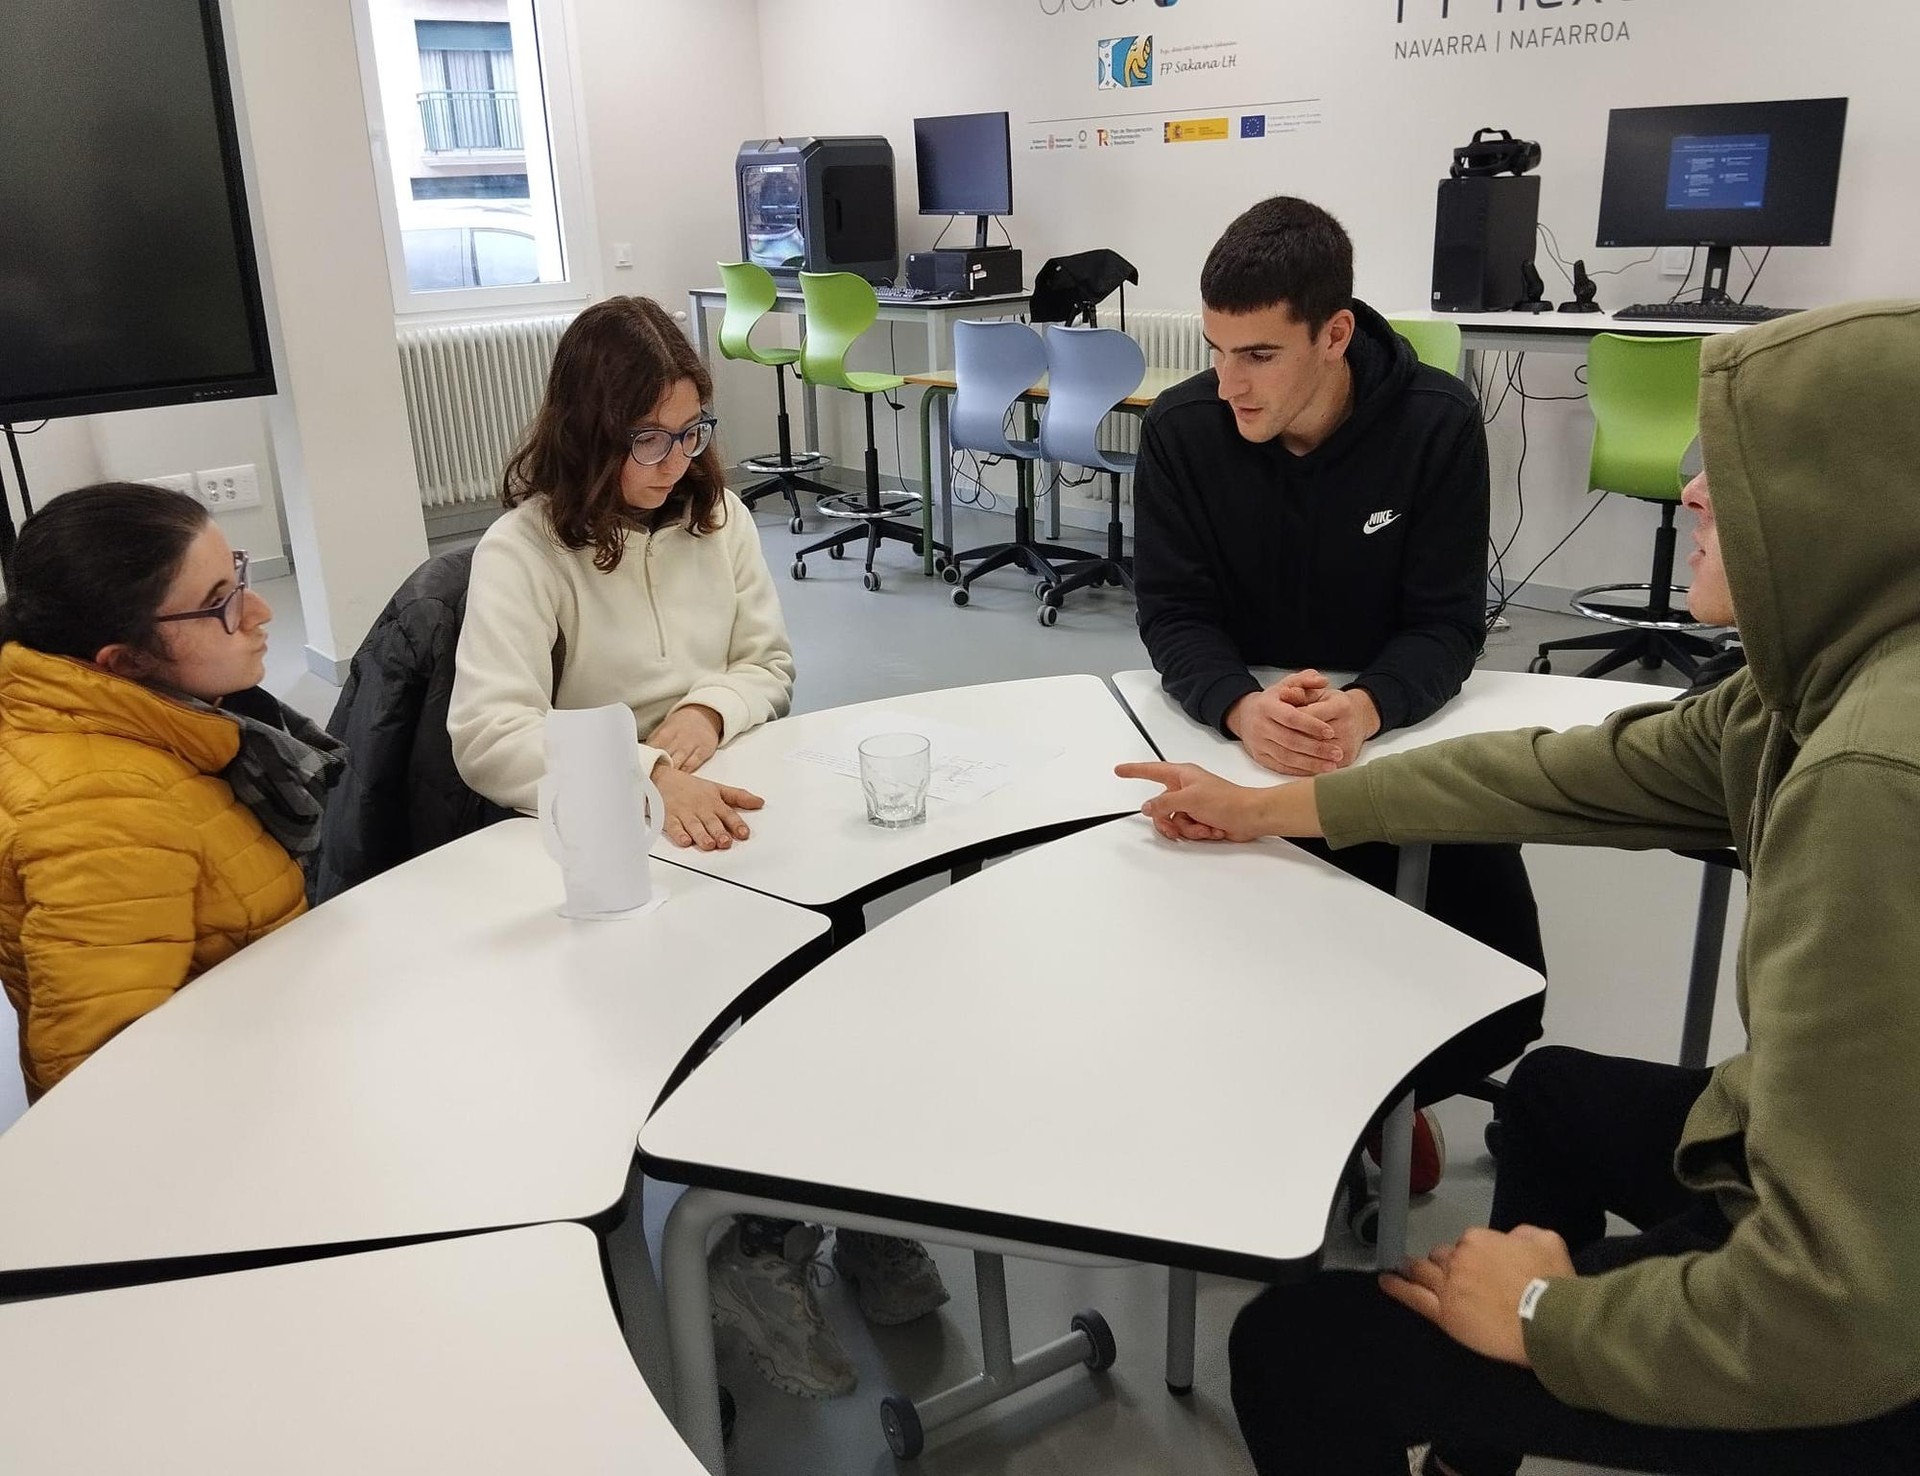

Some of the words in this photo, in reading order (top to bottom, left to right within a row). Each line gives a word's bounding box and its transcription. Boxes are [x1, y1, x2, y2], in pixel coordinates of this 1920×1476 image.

[1395, 34, 1487, 60] NAVARRA
[1510, 21, 1631, 50] NAFARROA
[1160, 62, 1173, 76] FP
[1174, 58, 1220, 74] Sakana
[1221, 54, 1237, 68] LH
[1369, 510, 1393, 525] NIKE
